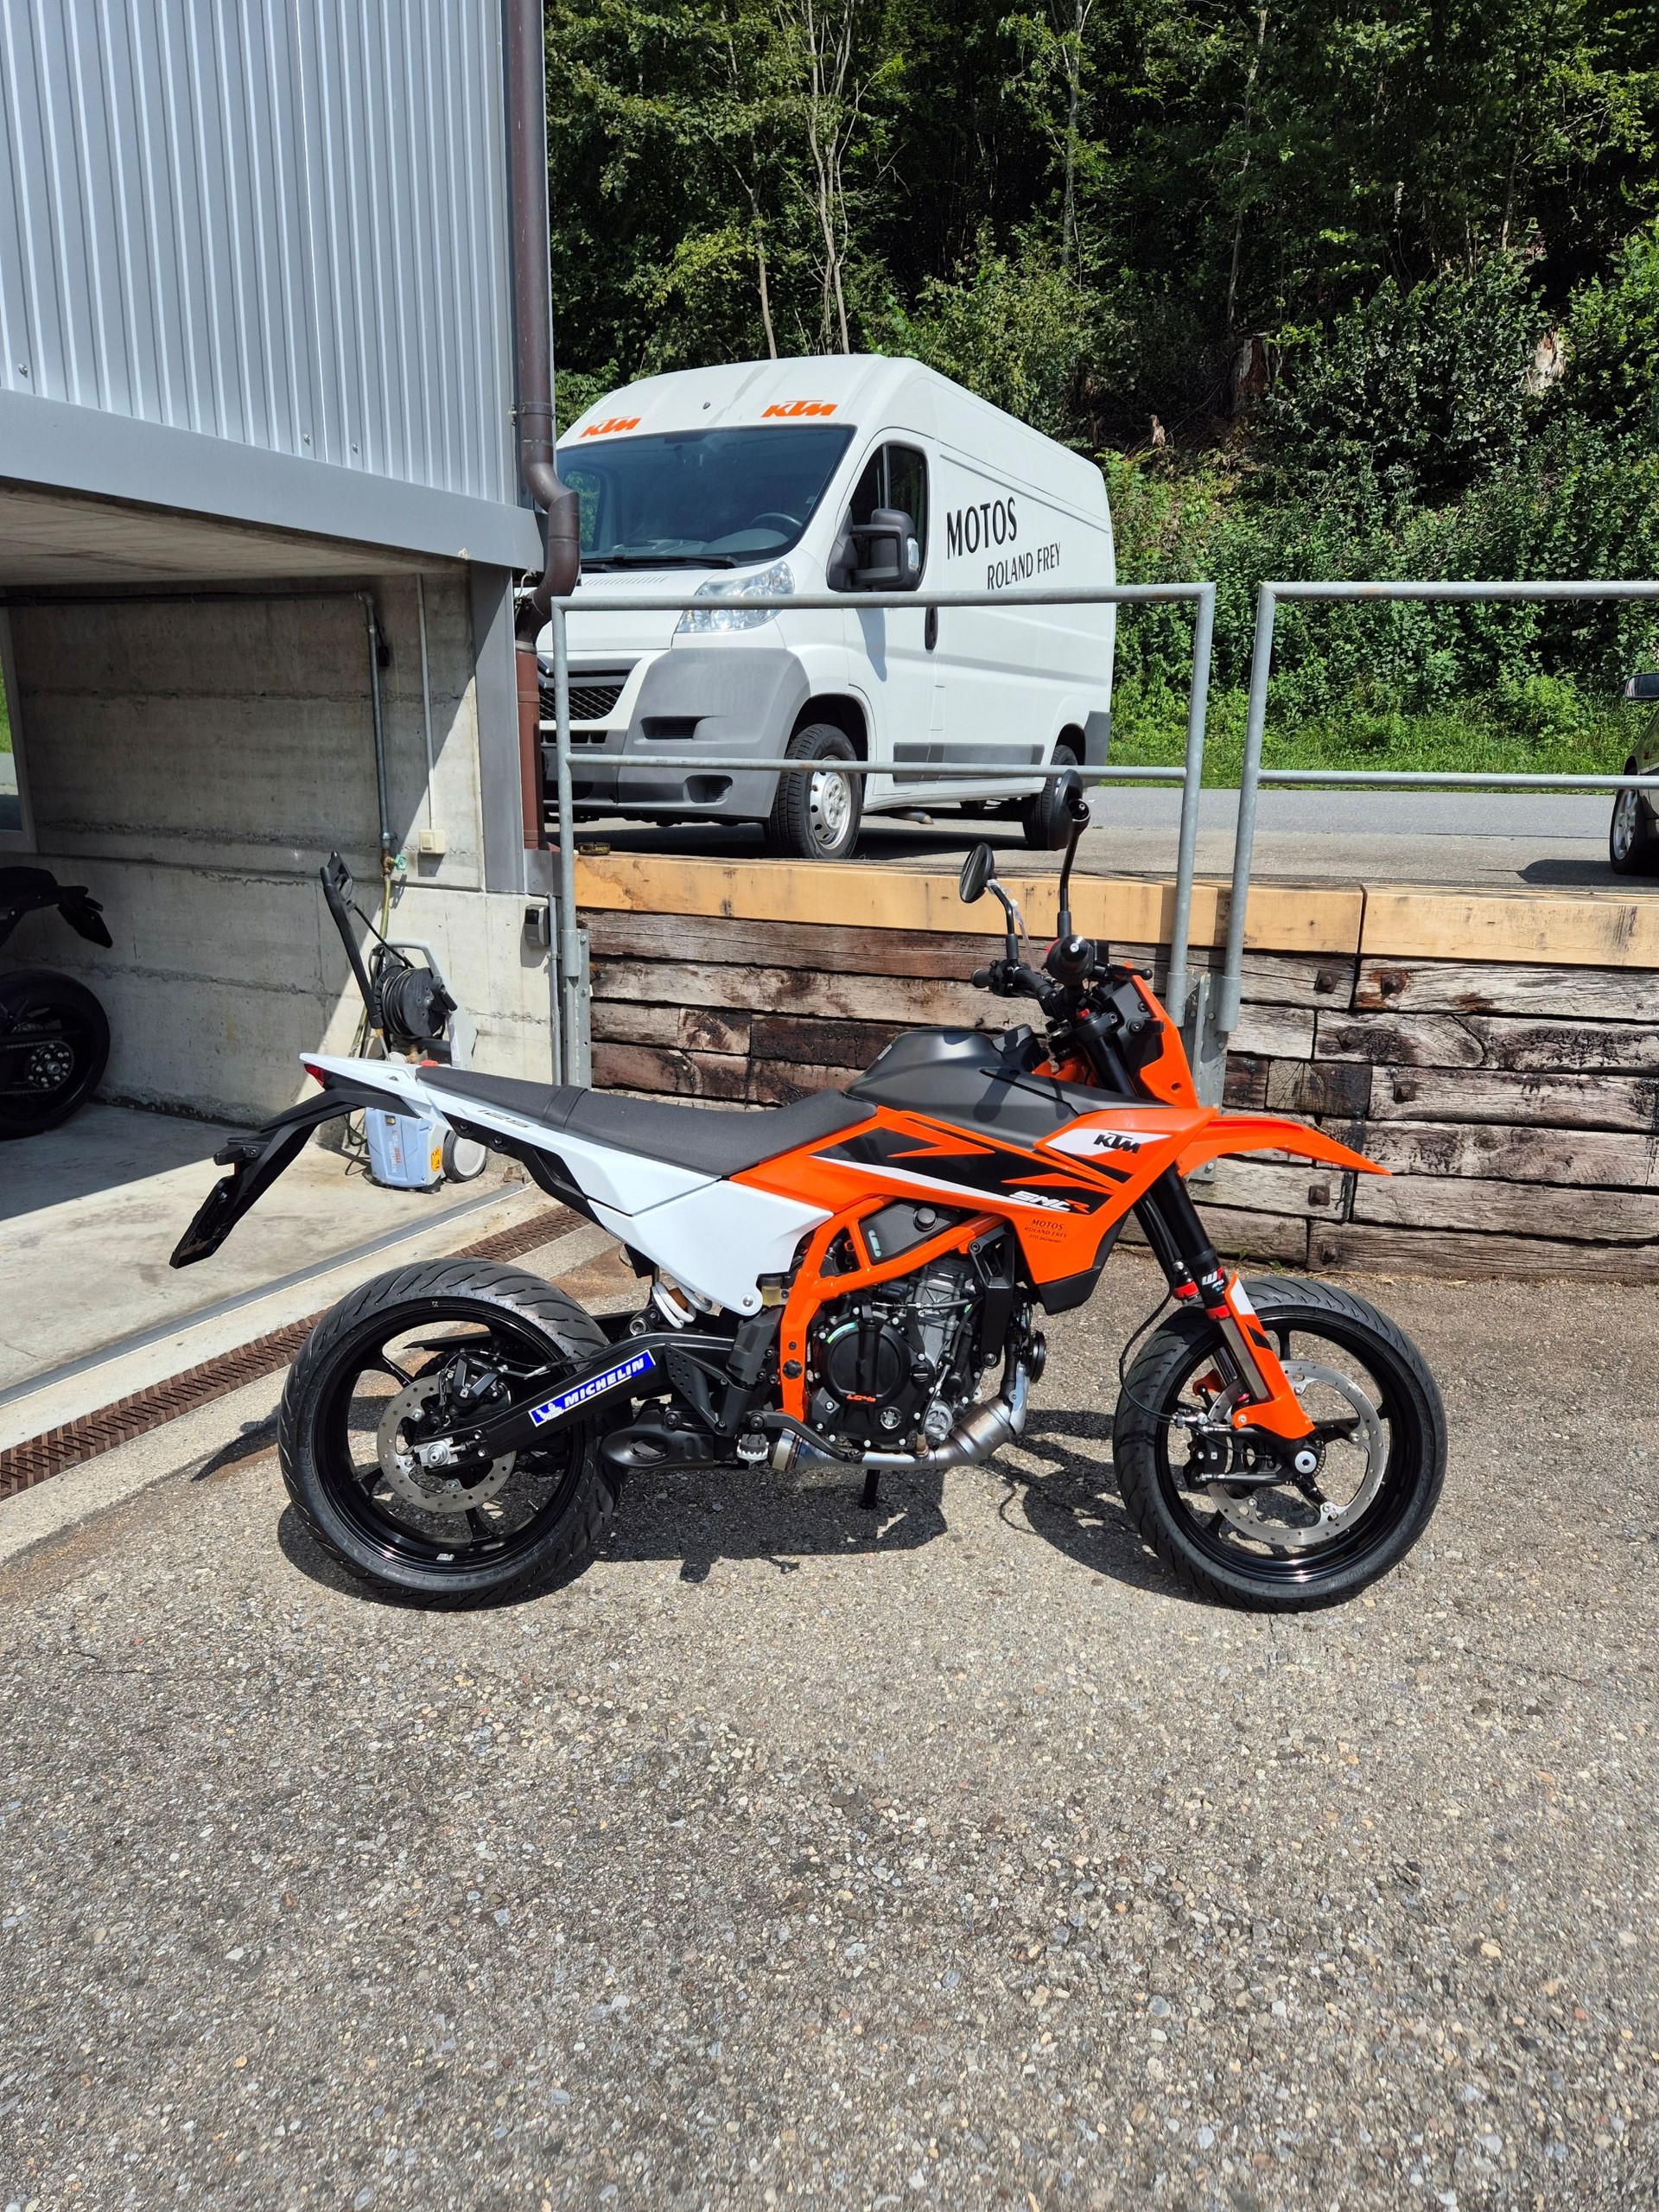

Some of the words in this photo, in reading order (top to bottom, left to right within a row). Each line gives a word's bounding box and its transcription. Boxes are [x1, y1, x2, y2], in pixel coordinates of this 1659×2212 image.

[760, 399, 838, 418] KTM
[579, 416, 641, 438] KTM
[946, 496, 1017, 560] MOTOS
[987, 552, 1033, 590] ROLAND
[1037, 542, 1061, 574] FREY
[1093, 1132, 1141, 1154] KTM
[1024, 1226, 1051, 1236] ROLAND
[1032, 1218, 1065, 1230] MOTOS
[563, 1357, 645, 1408] MICHELIN
